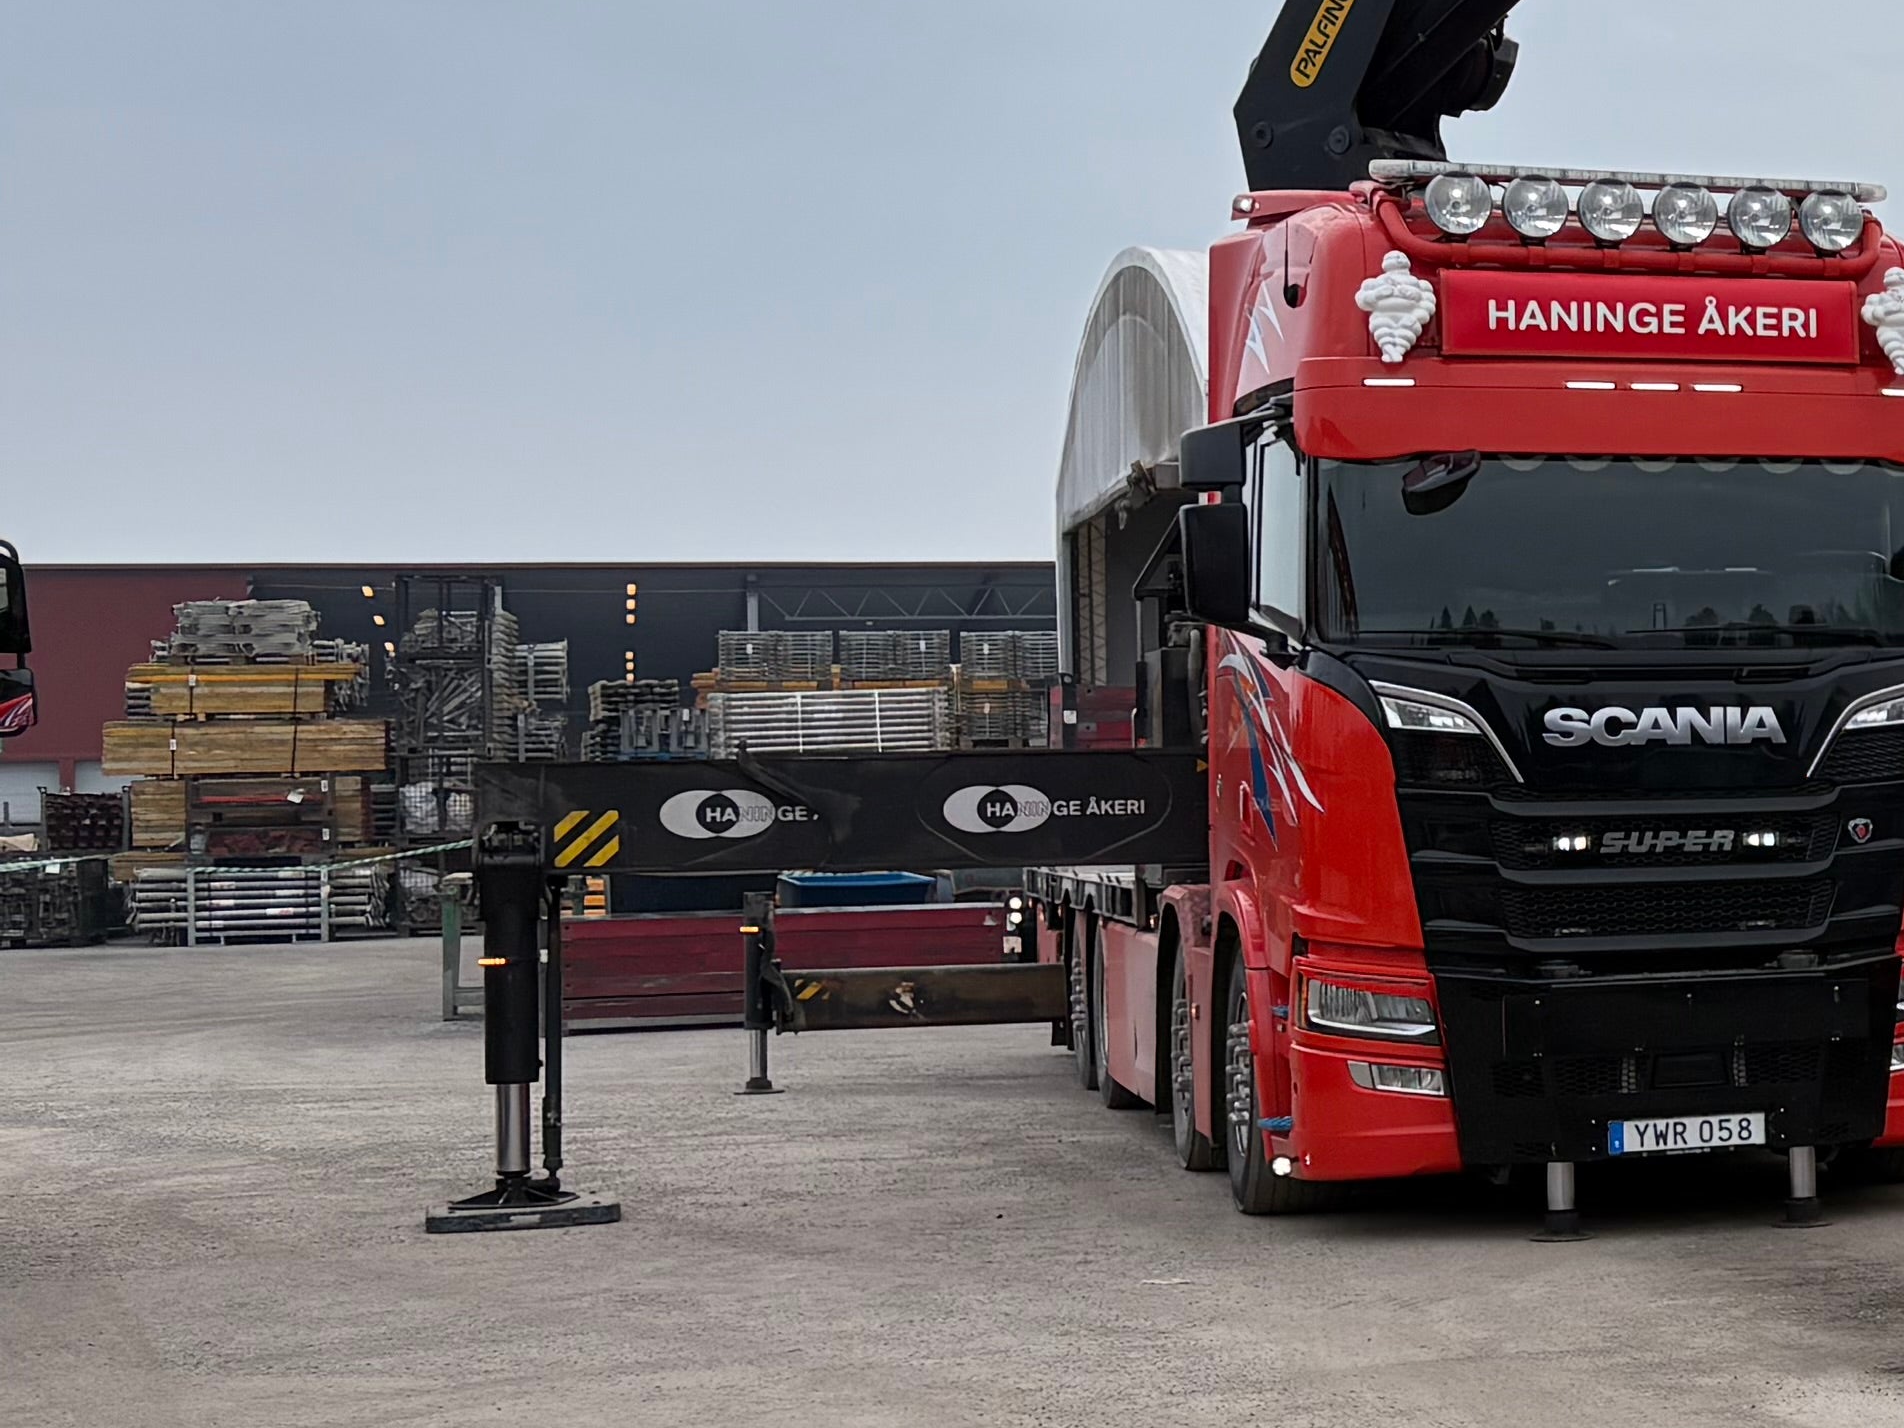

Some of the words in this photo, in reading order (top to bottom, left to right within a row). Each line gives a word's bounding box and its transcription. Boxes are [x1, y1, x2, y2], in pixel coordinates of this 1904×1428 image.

[1487, 299, 1686, 335] HANINGE
[1697, 295, 1818, 339] ÅKERI
[1542, 706, 1788, 747] SCANIA
[705, 805, 809, 823] HANINGE
[986, 800, 1082, 818] HANINGE
[1086, 796, 1146, 816] ÅKERI
[1600, 829, 1736, 854] SUPER
[1634, 1121, 1688, 1148] YWR
[1699, 1117, 1753, 1143] 058
